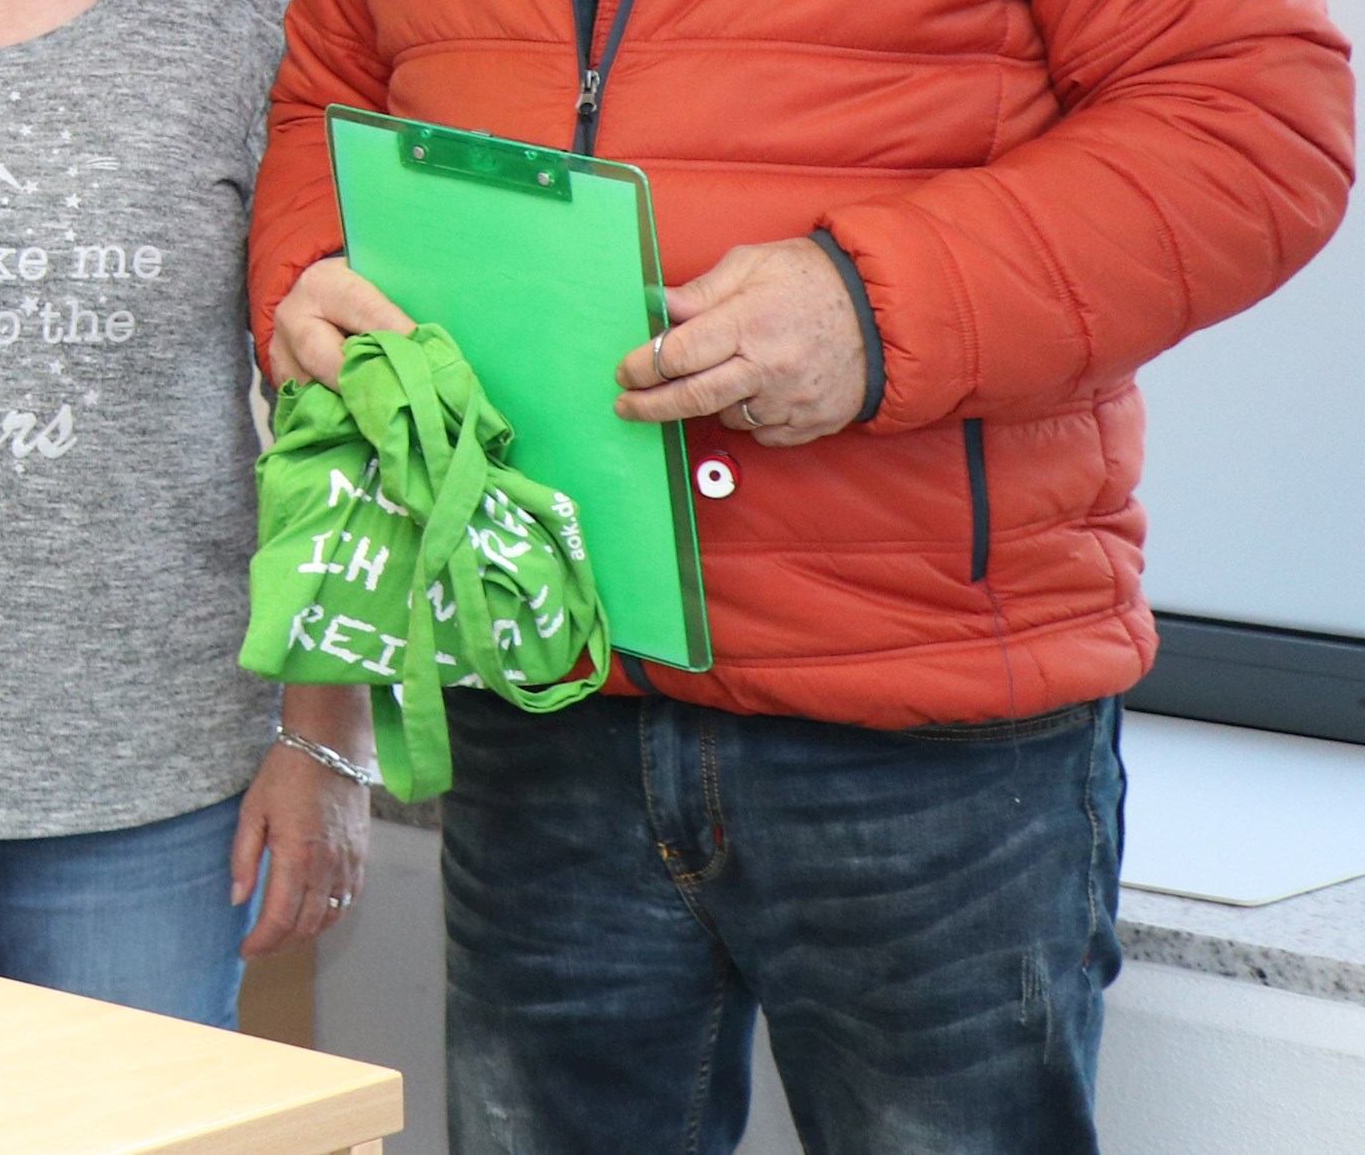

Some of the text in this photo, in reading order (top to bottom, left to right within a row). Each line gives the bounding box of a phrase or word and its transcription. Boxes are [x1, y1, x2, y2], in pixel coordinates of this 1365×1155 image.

[72, 243, 164, 281] me
[39, 300, 136, 344] the
[551, 491, 586, 562] aok.de
